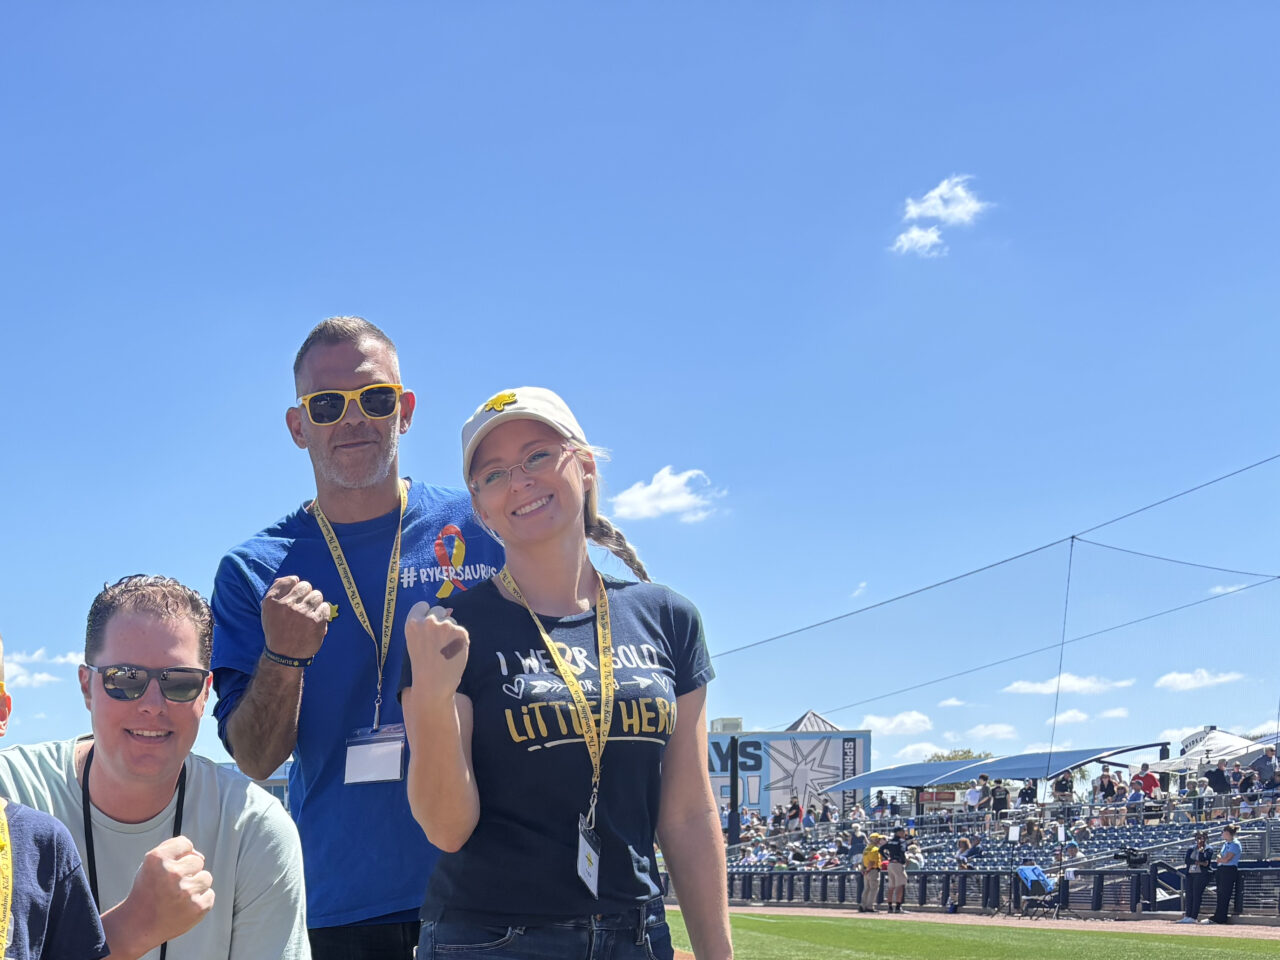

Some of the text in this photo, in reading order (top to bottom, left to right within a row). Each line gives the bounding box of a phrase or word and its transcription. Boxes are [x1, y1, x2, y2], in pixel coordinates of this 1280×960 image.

[495, 651, 508, 676] I
[708, 740, 762, 773] YS
[2, 874, 10, 890] Kids
[0, 891, 9, 925] Sunshine
